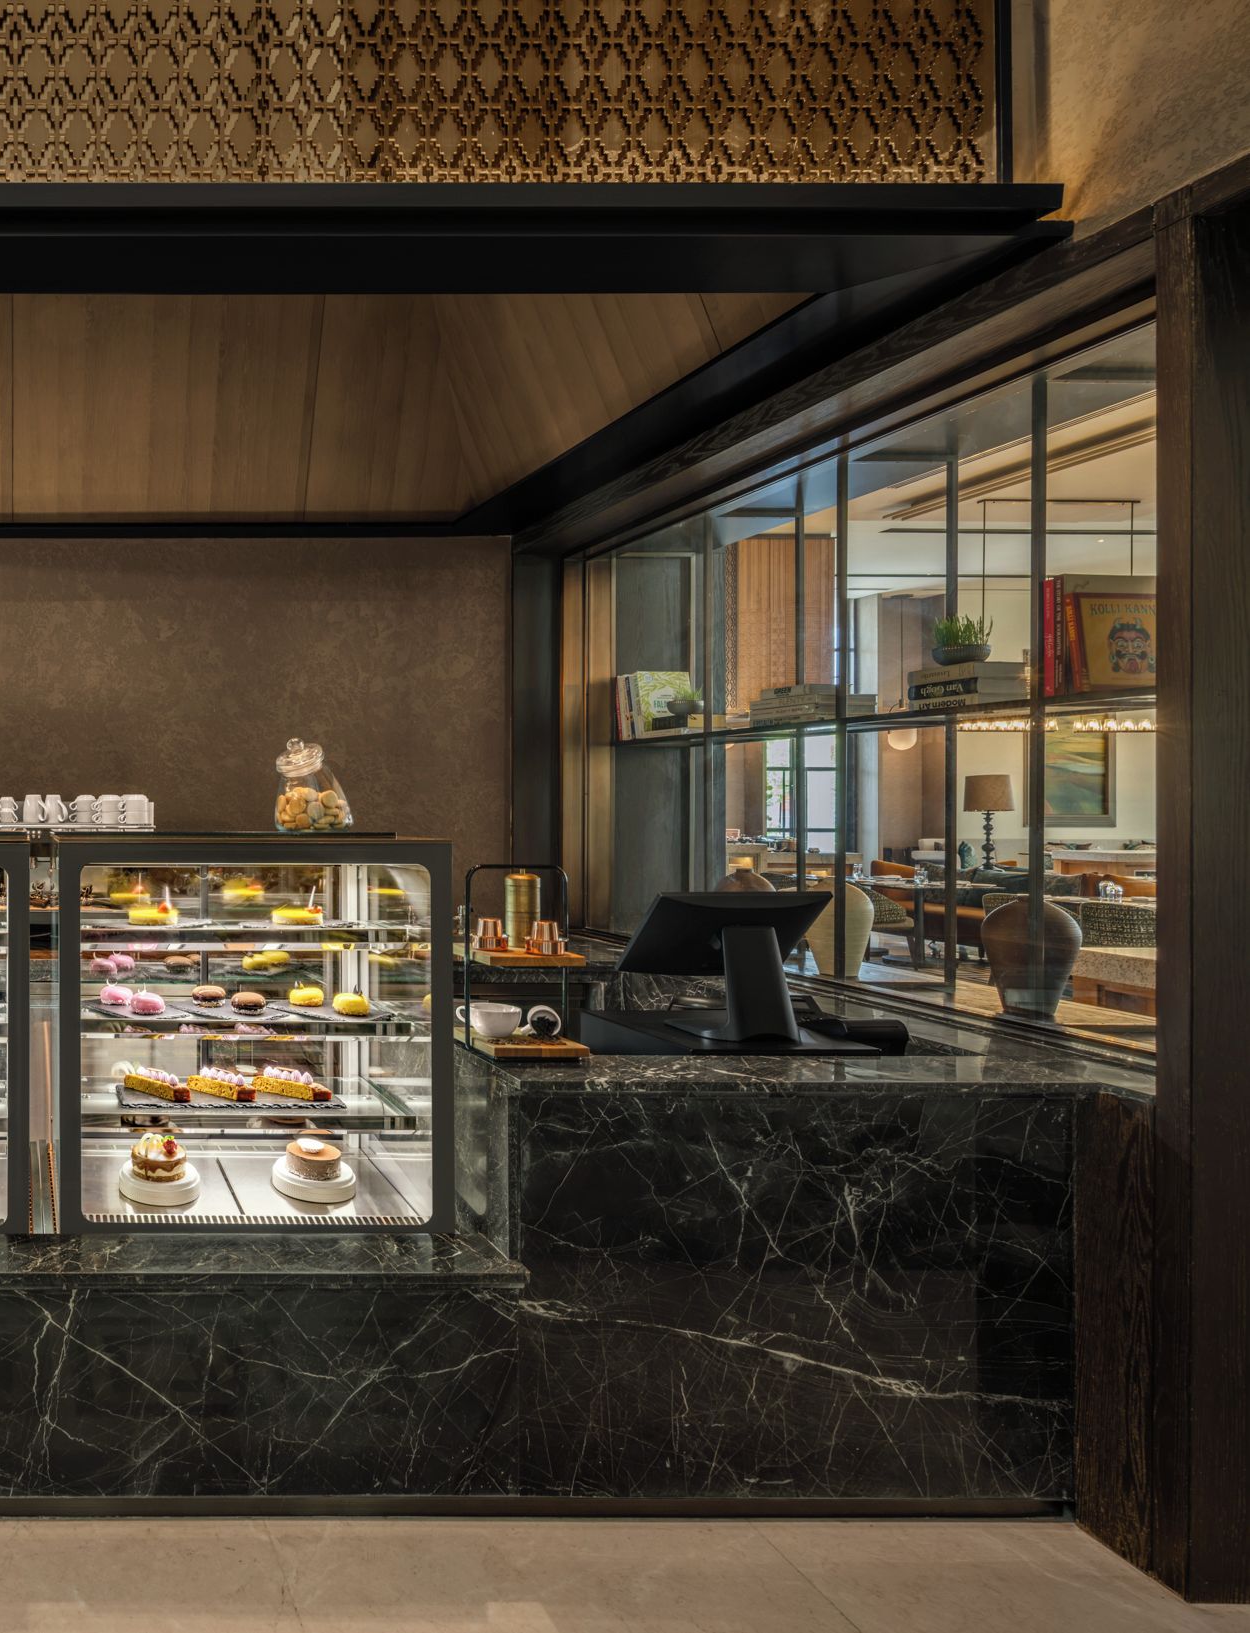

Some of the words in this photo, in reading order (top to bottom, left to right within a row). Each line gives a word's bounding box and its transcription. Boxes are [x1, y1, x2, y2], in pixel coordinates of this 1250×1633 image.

[1091, 603, 1121, 615] KOLLI
[920, 685, 944, 696] Gogh
[946, 684, 964, 692] Van
[933, 699, 965, 708] Modern
